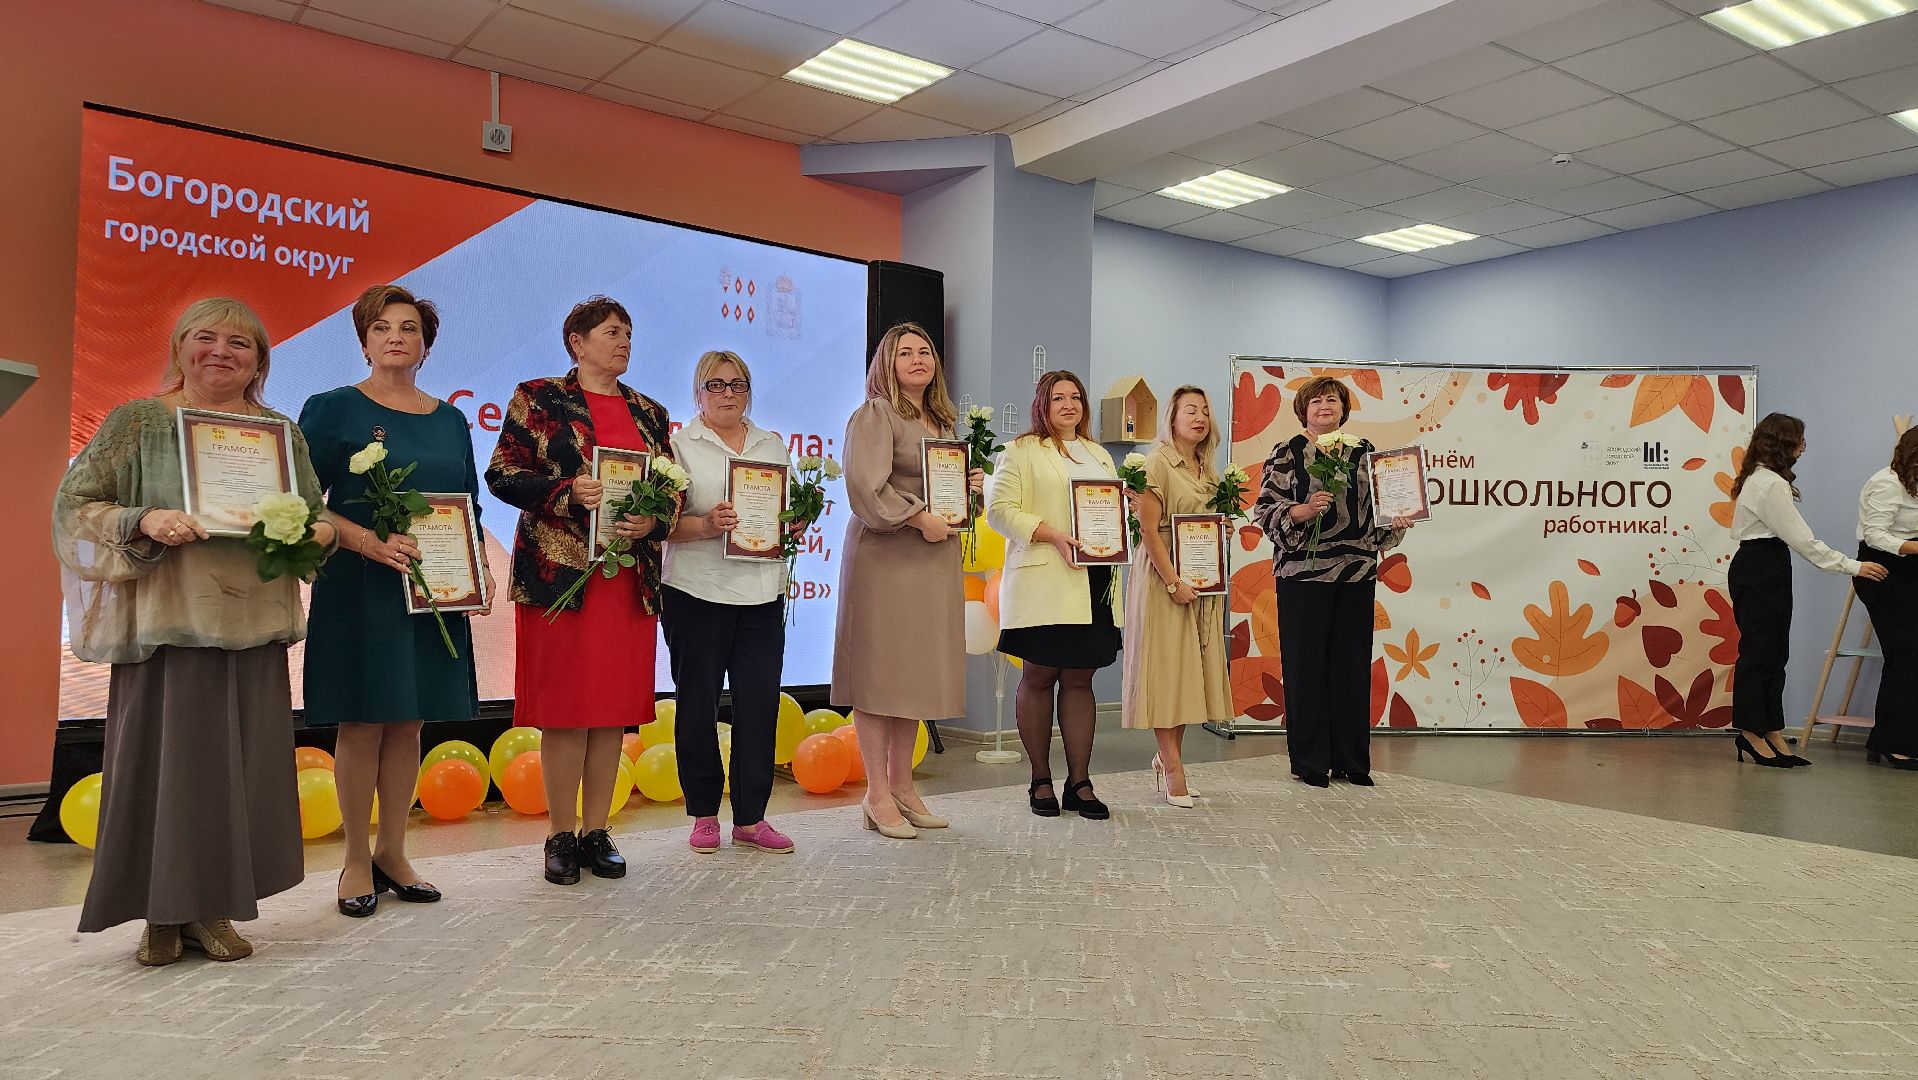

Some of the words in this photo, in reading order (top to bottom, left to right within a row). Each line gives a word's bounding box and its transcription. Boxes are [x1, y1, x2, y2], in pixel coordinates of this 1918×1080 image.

[107, 155, 370, 233] Богородский
[104, 219, 266, 261] городской
[275, 245, 355, 279] округ
[212, 443, 260, 455] ГРАМОТА
[743, 483, 771, 492] ГРАМОТА
[1427, 478, 1672, 508] ОШКОЛЬНОГО
[1543, 515, 1668, 538] работника!
